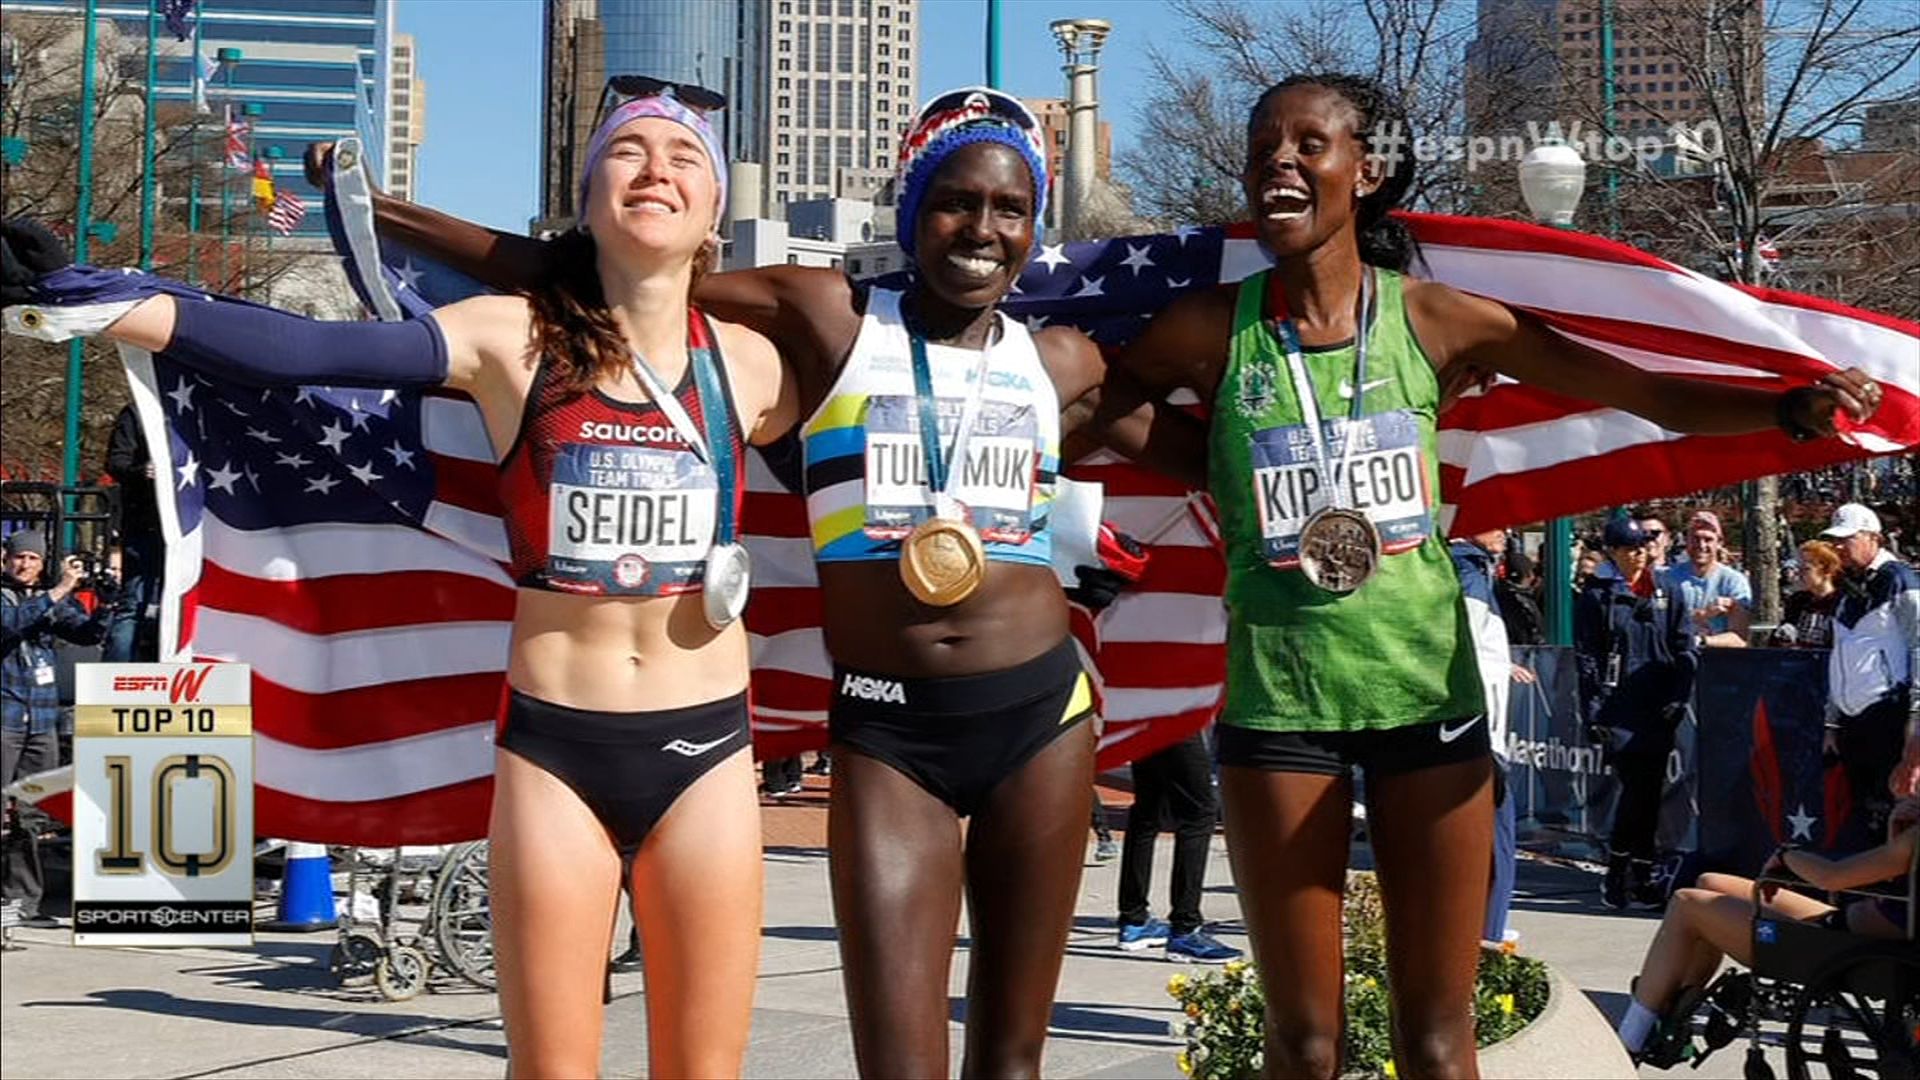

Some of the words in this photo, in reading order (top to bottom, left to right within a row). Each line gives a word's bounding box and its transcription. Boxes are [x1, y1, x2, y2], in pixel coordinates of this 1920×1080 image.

[578, 421, 690, 449] saucon
[588, 470, 629, 488] TEAM
[871, 442, 1030, 491] TULMUK
[1261, 452, 1416, 521] KIPEGO
[566, 490, 697, 547] SEIDEL
[841, 674, 907, 704] HOKA
